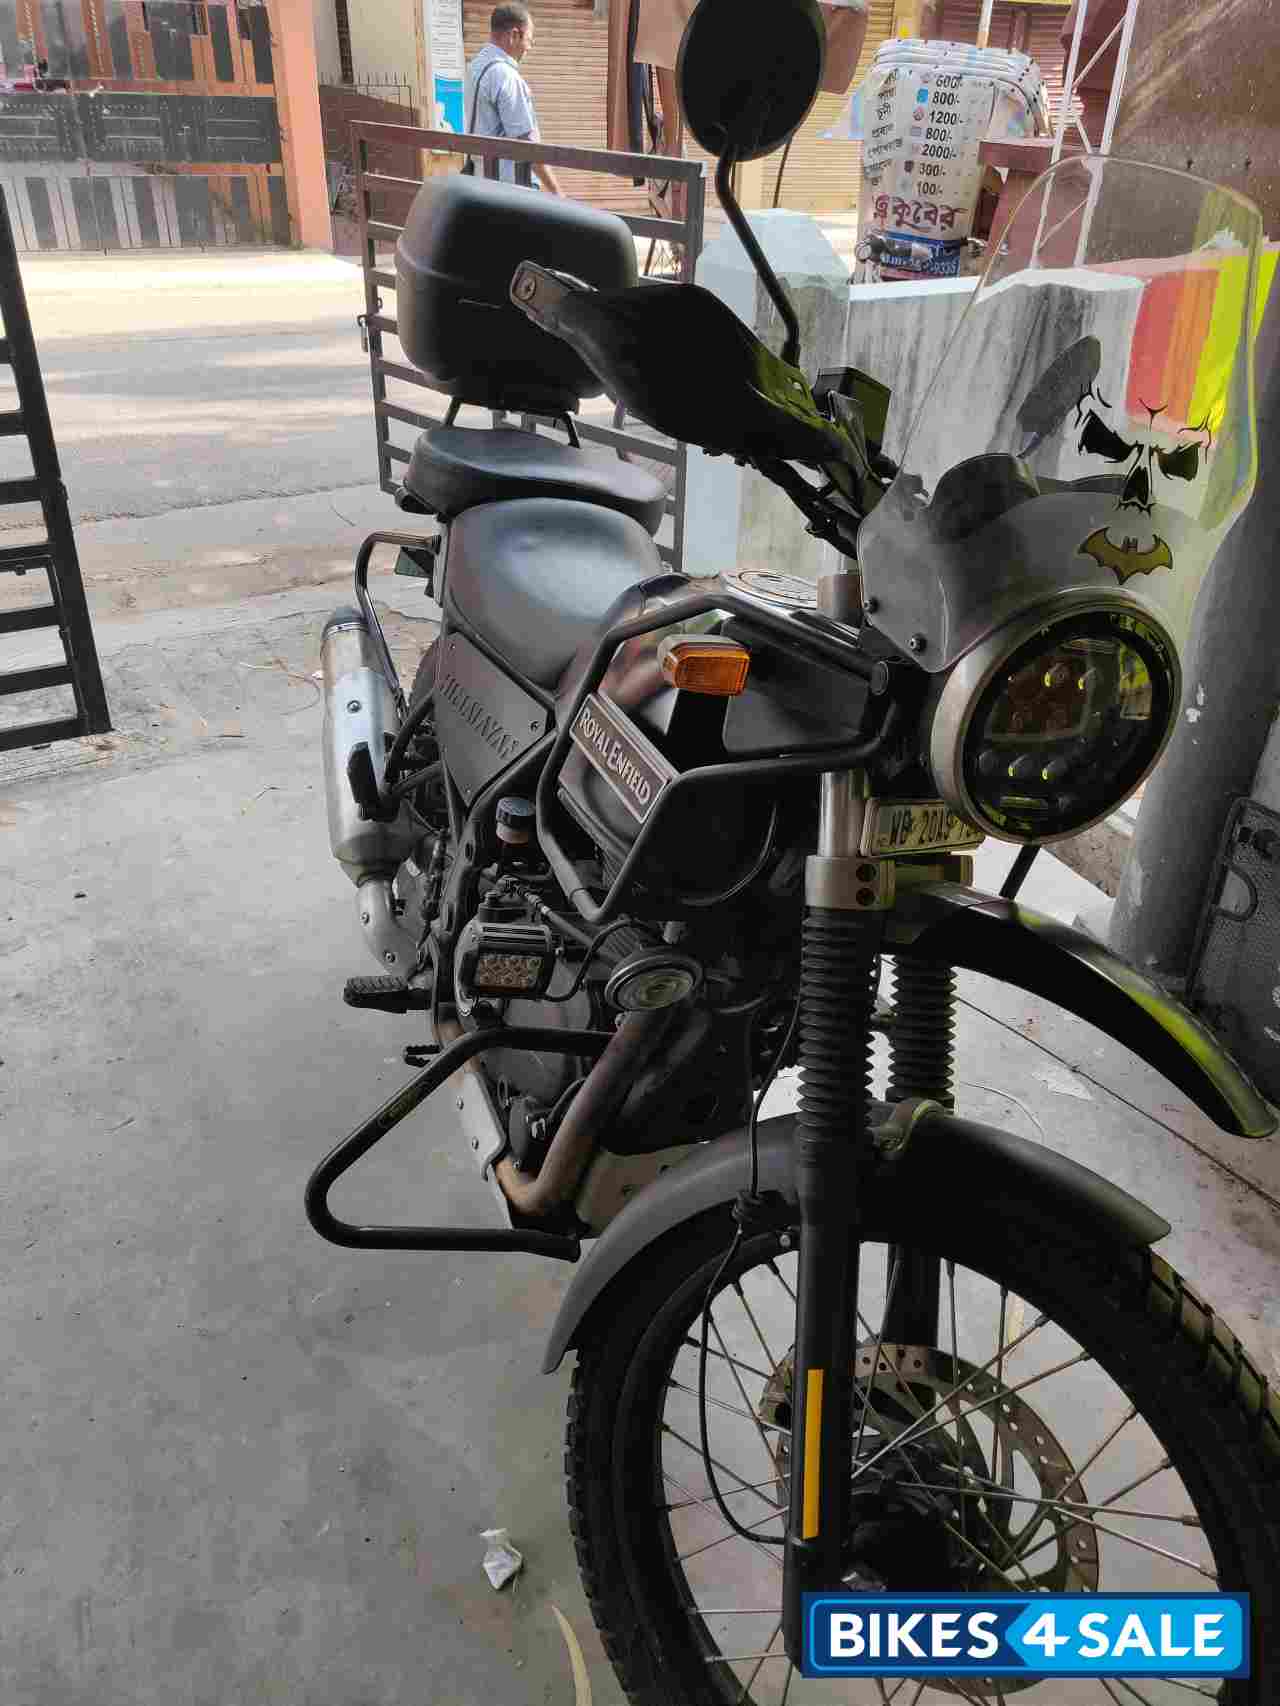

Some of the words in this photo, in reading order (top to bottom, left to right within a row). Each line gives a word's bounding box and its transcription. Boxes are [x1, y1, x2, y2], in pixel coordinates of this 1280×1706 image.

[932, 91, 960, 105] 800/-
[929, 110, 964, 125] 1200/-
[926, 127, 953, 141] 800/-
[922, 144, 957, 159] 2000/-
[579, 707, 610, 757] ROYAL
[607, 740, 650, 805] ENFIELD
